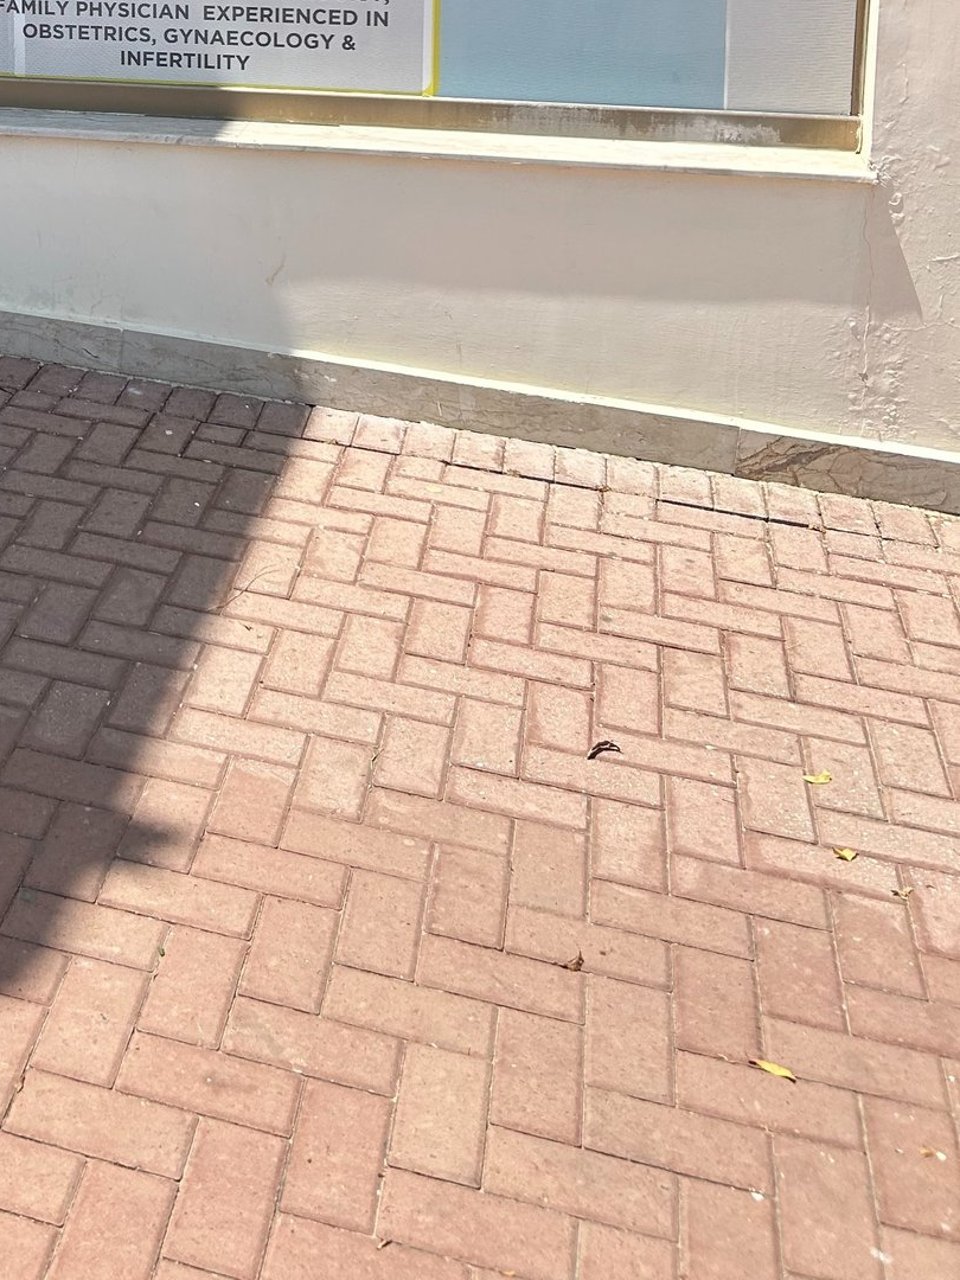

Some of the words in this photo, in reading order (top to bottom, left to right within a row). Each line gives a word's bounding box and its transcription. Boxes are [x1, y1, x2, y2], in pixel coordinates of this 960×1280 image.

[76, 0, 189, 20] PHYSICIAN
[203, 5, 359, 26] EXPERIENCED
[366, 10, 389, 27] IN
[22, 23, 157, 46] OBSTETRICS,
[163, 27, 335, 50] GYNAECOLOGY
[341, 34, 356, 51] &
[120, 50, 251, 71] INFERTILITY
